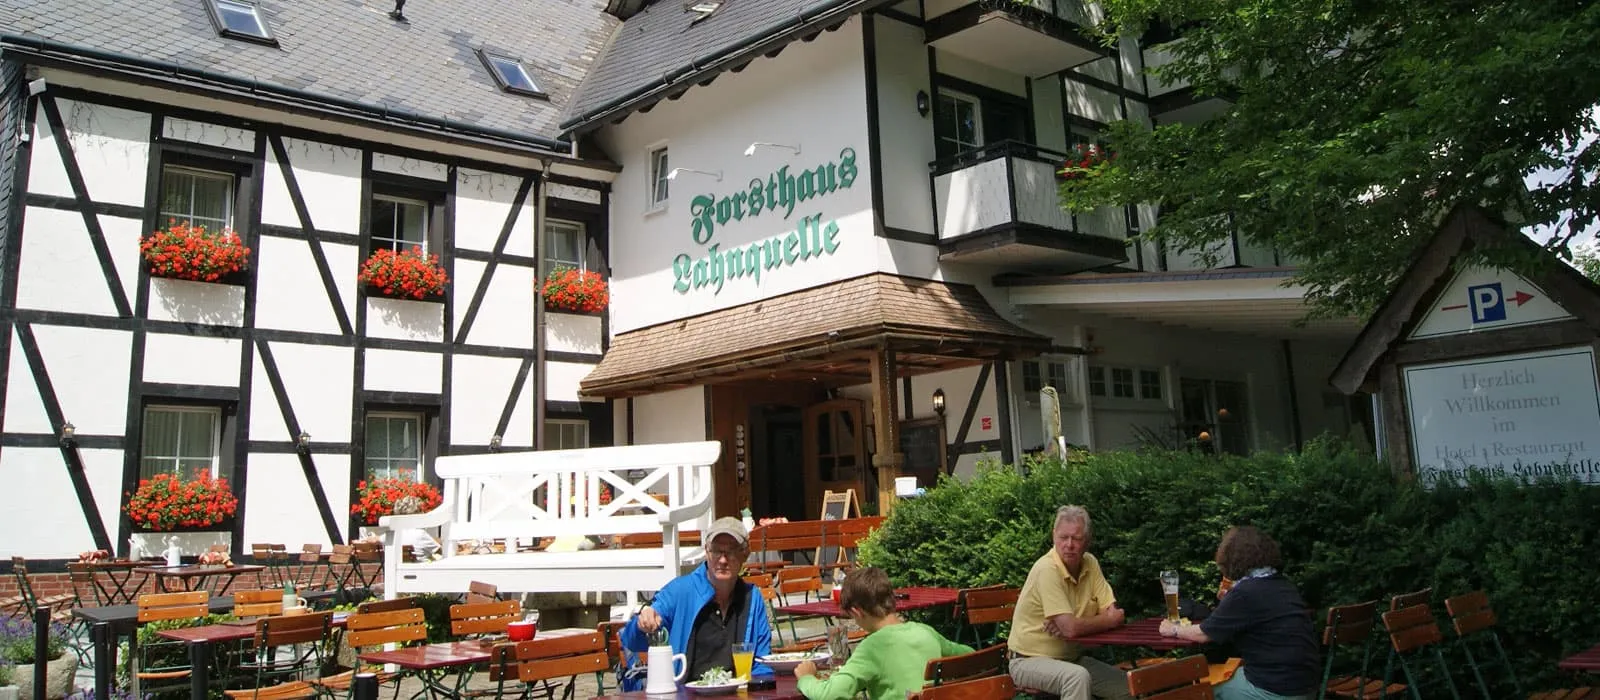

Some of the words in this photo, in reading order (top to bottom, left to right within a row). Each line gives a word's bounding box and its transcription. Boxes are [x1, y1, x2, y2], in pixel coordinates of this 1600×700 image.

[690, 147, 858, 244] Forsthaus
[672, 212, 841, 296] Lahnquelle
[1474, 287, 1499, 320] P
[1461, 367, 1535, 390] Herzlich
[1444, 394, 1561, 415] Willkommen
[1492, 416, 1516, 433] im
[1434, 443, 1476, 460] Hotel
[1493, 441, 1588, 458] Restaurant
